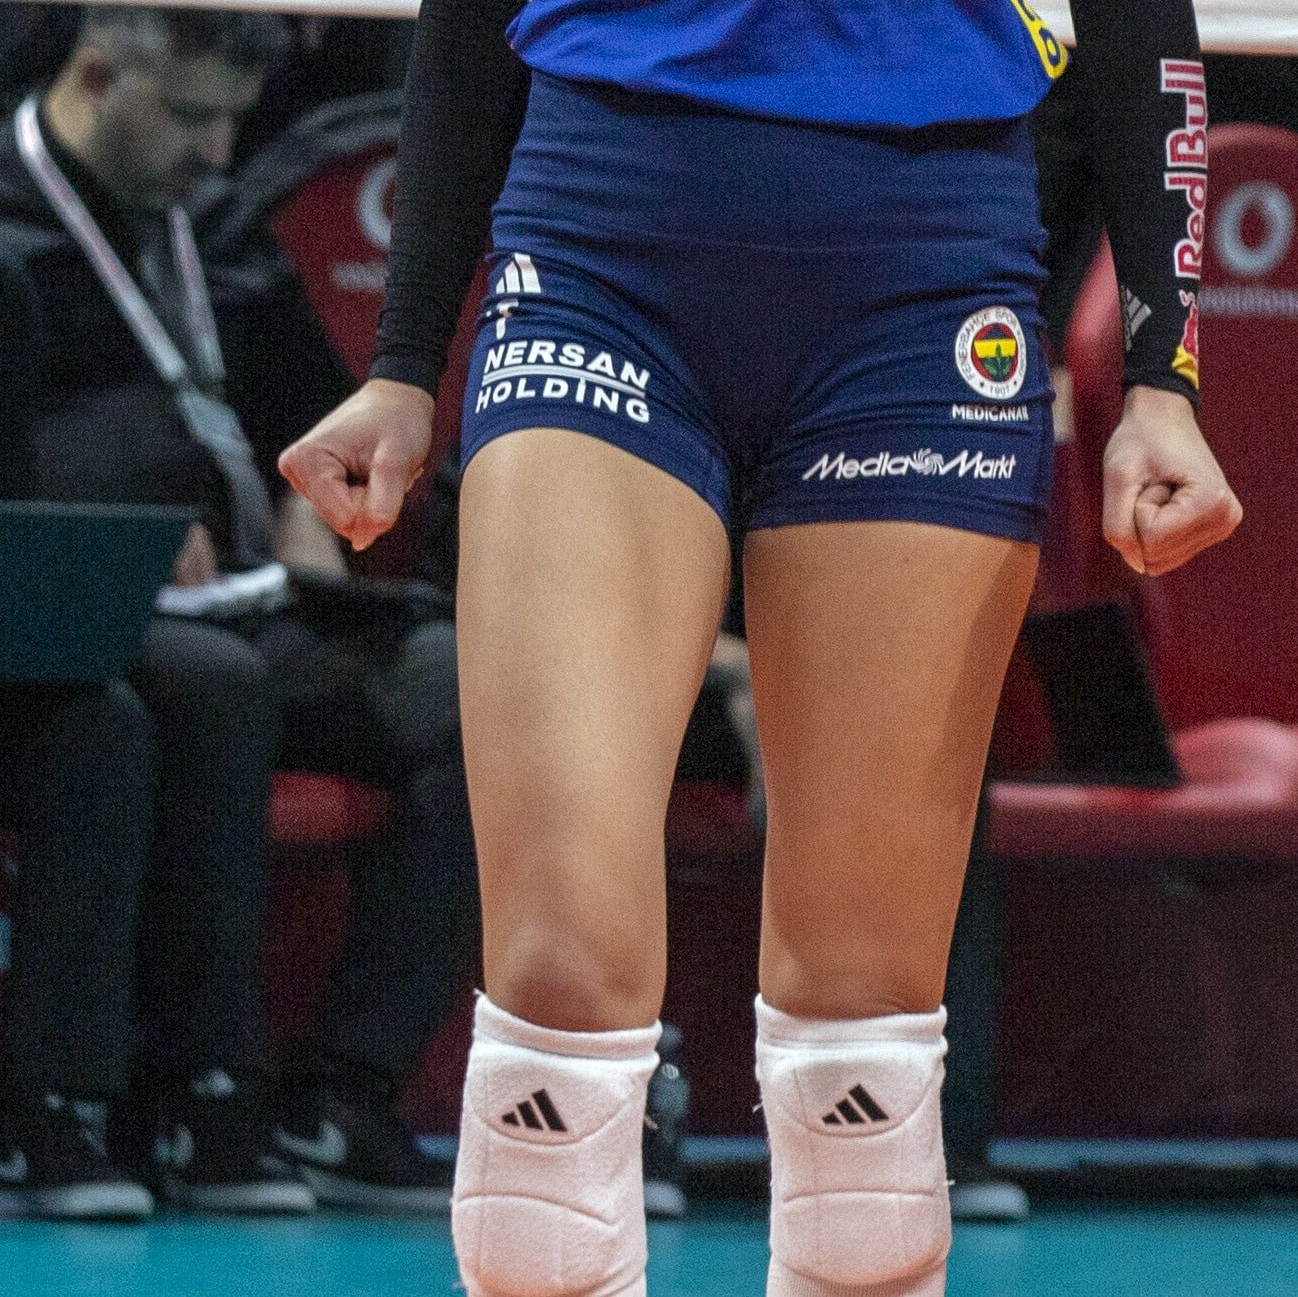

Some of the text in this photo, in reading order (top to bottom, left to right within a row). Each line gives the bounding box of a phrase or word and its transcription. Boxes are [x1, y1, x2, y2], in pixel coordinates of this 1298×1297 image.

[1160, 59, 1207, 279] Red Bull
[484, 340, 650, 390] NERSAN
